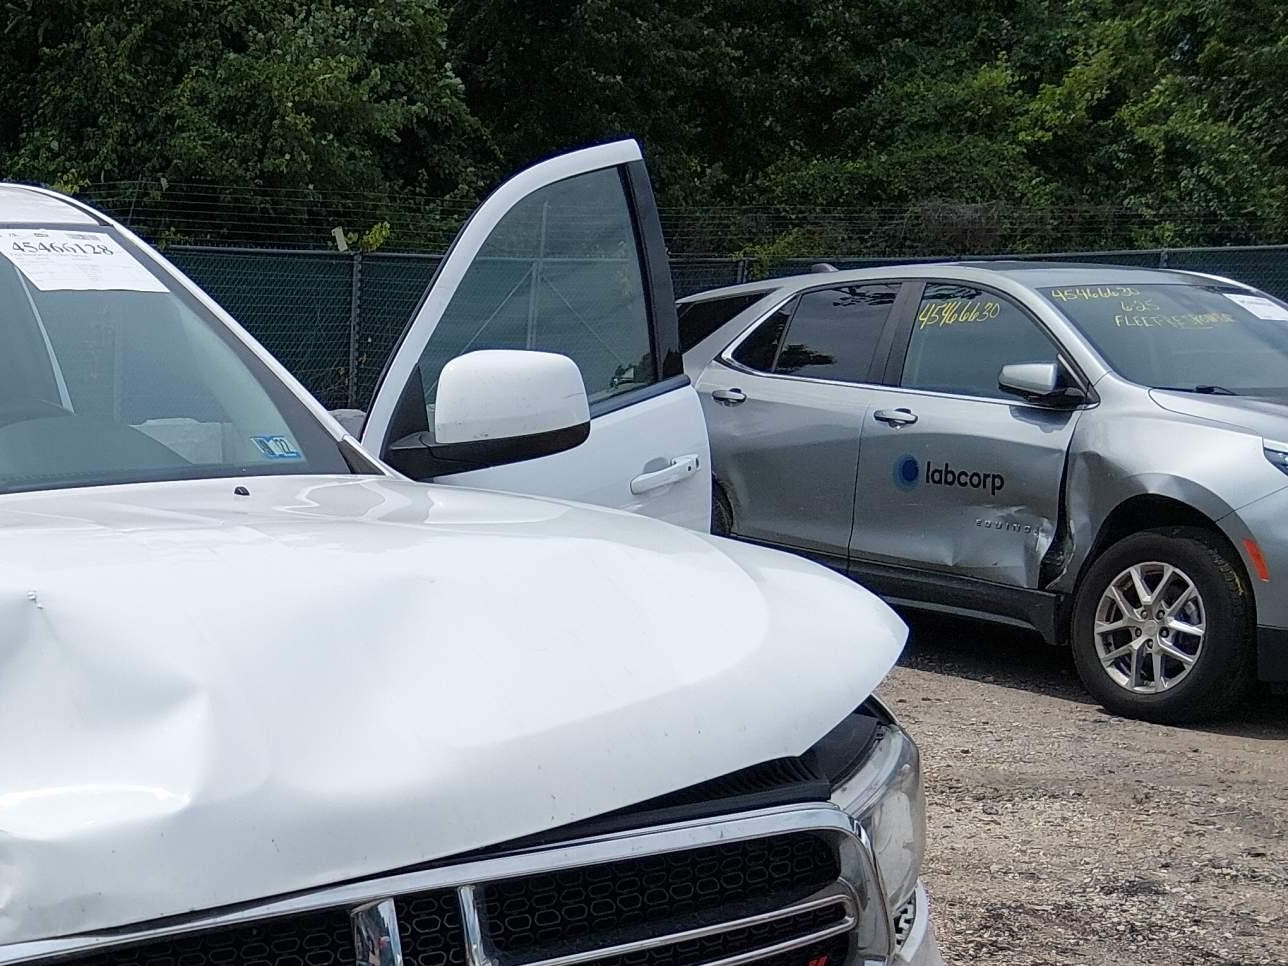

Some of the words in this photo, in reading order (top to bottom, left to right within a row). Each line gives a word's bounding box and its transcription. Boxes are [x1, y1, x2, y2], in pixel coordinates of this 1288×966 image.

[12, 241, 114, 255] 45466128
[919, 301, 1000, 330] 45466630
[925, 461, 1005, 496] labcorp
